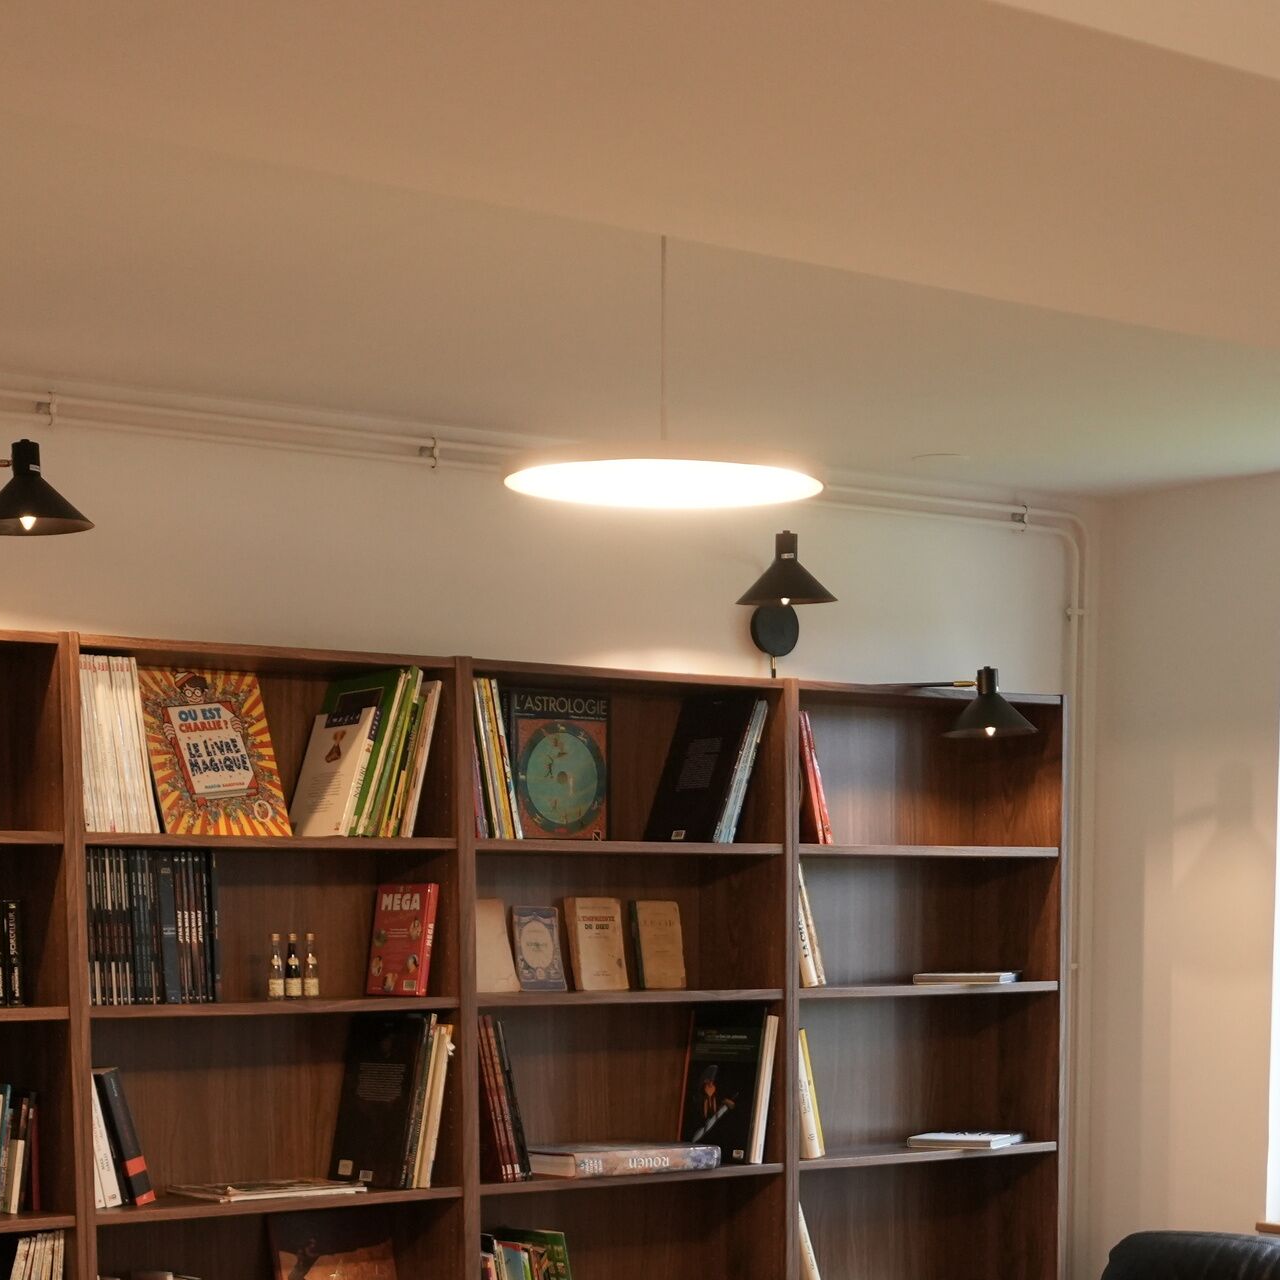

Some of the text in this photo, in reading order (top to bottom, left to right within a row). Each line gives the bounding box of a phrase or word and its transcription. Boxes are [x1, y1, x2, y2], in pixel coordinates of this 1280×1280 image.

[200, 707, 222, 720] EST
[514, 694, 608, 716] L'ASTROLOGIE
[179, 721, 223, 733] CHARLIE
[186, 737, 241, 759] LE LIVRE
[188, 753, 250, 776] MAGIQUE
[353, 765, 368, 798] NATURE
[381, 893, 420, 911] MEGA
[8, 912, 19, 955] SORCELEUR
[628, 1156, 670, 1169] ROUEN
